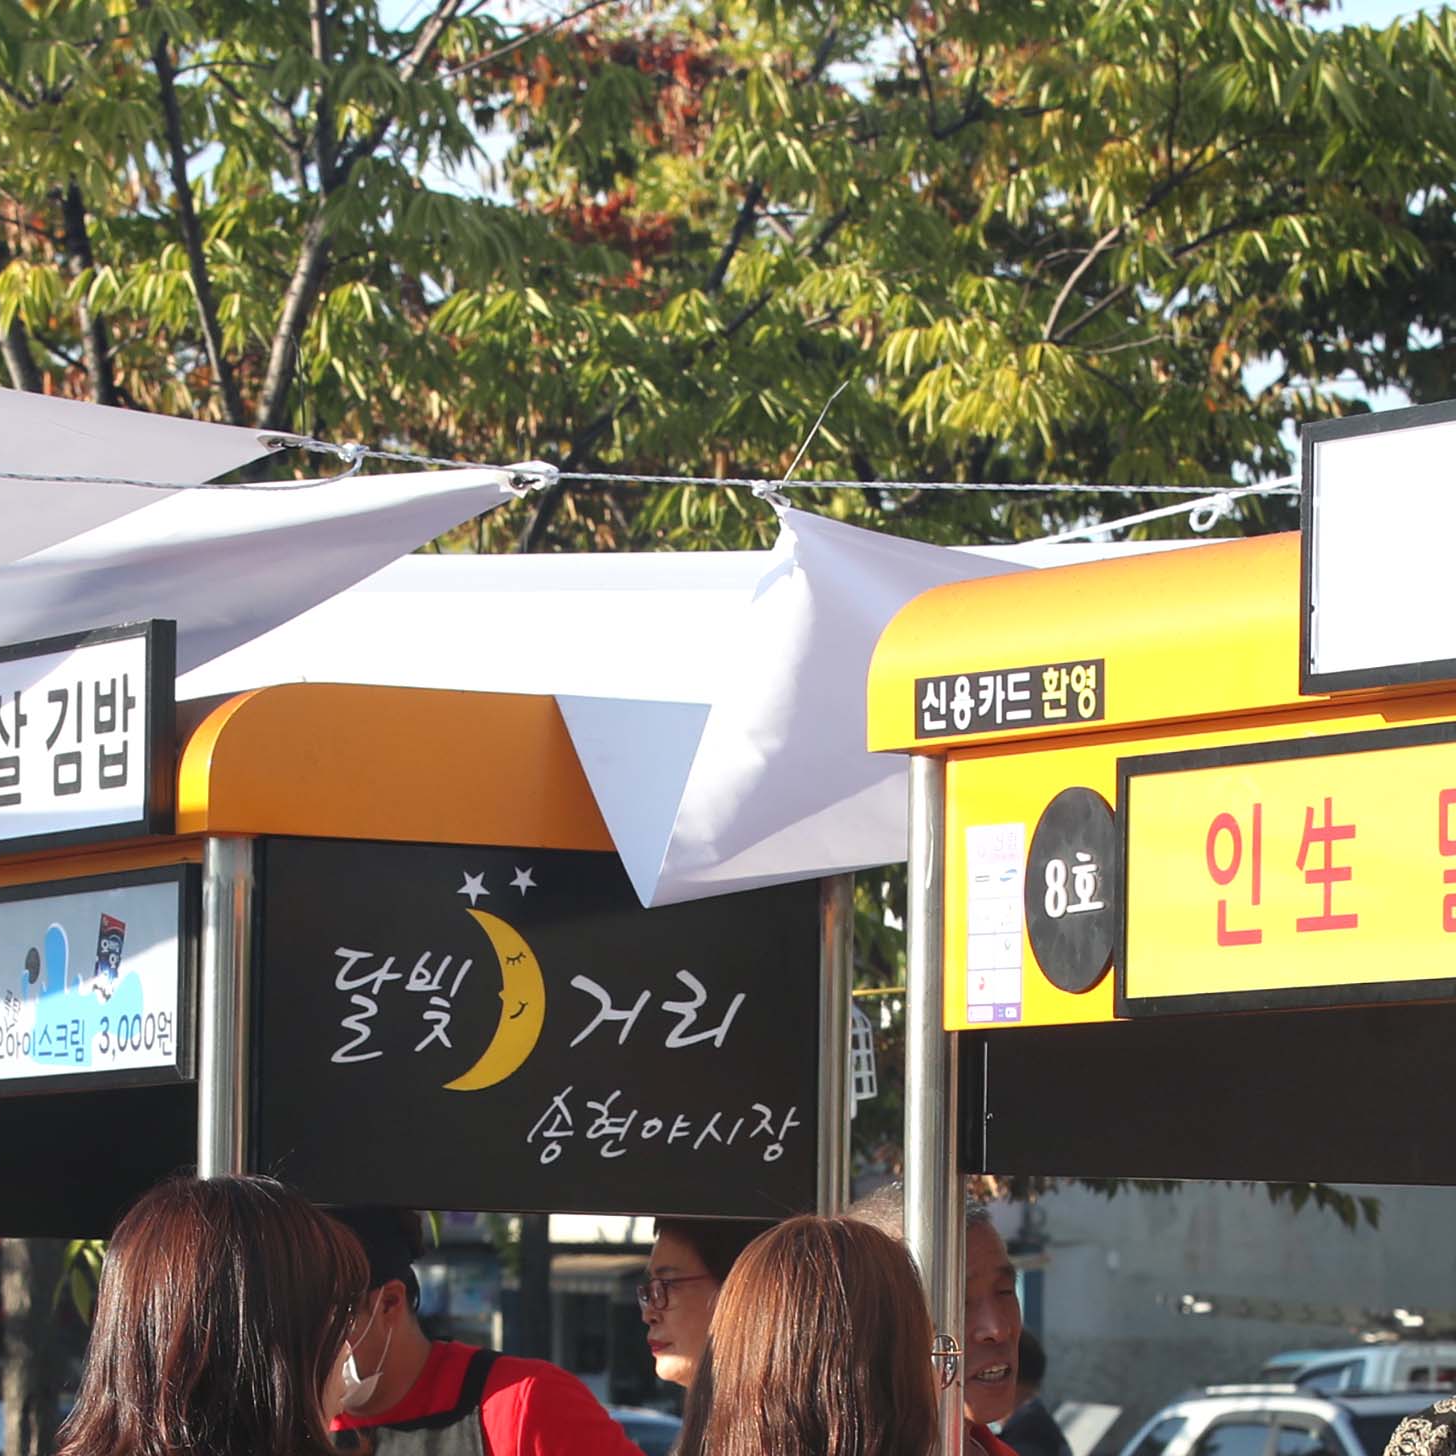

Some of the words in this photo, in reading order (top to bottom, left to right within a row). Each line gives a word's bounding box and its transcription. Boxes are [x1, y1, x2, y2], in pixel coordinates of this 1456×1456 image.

[922, 671, 1032, 731] 신용카드
[1042, 664, 1097, 719] 환영
[46, 673, 135, 797] 김밥
[1045, 852, 1105, 918] 8호
[98, 1010, 174, 1061] 3,000원
[330, 946, 473, 1063] 달빛
[570, 970, 746, 1049] 거리
[527, 1085, 800, 1164] 송현야시장
